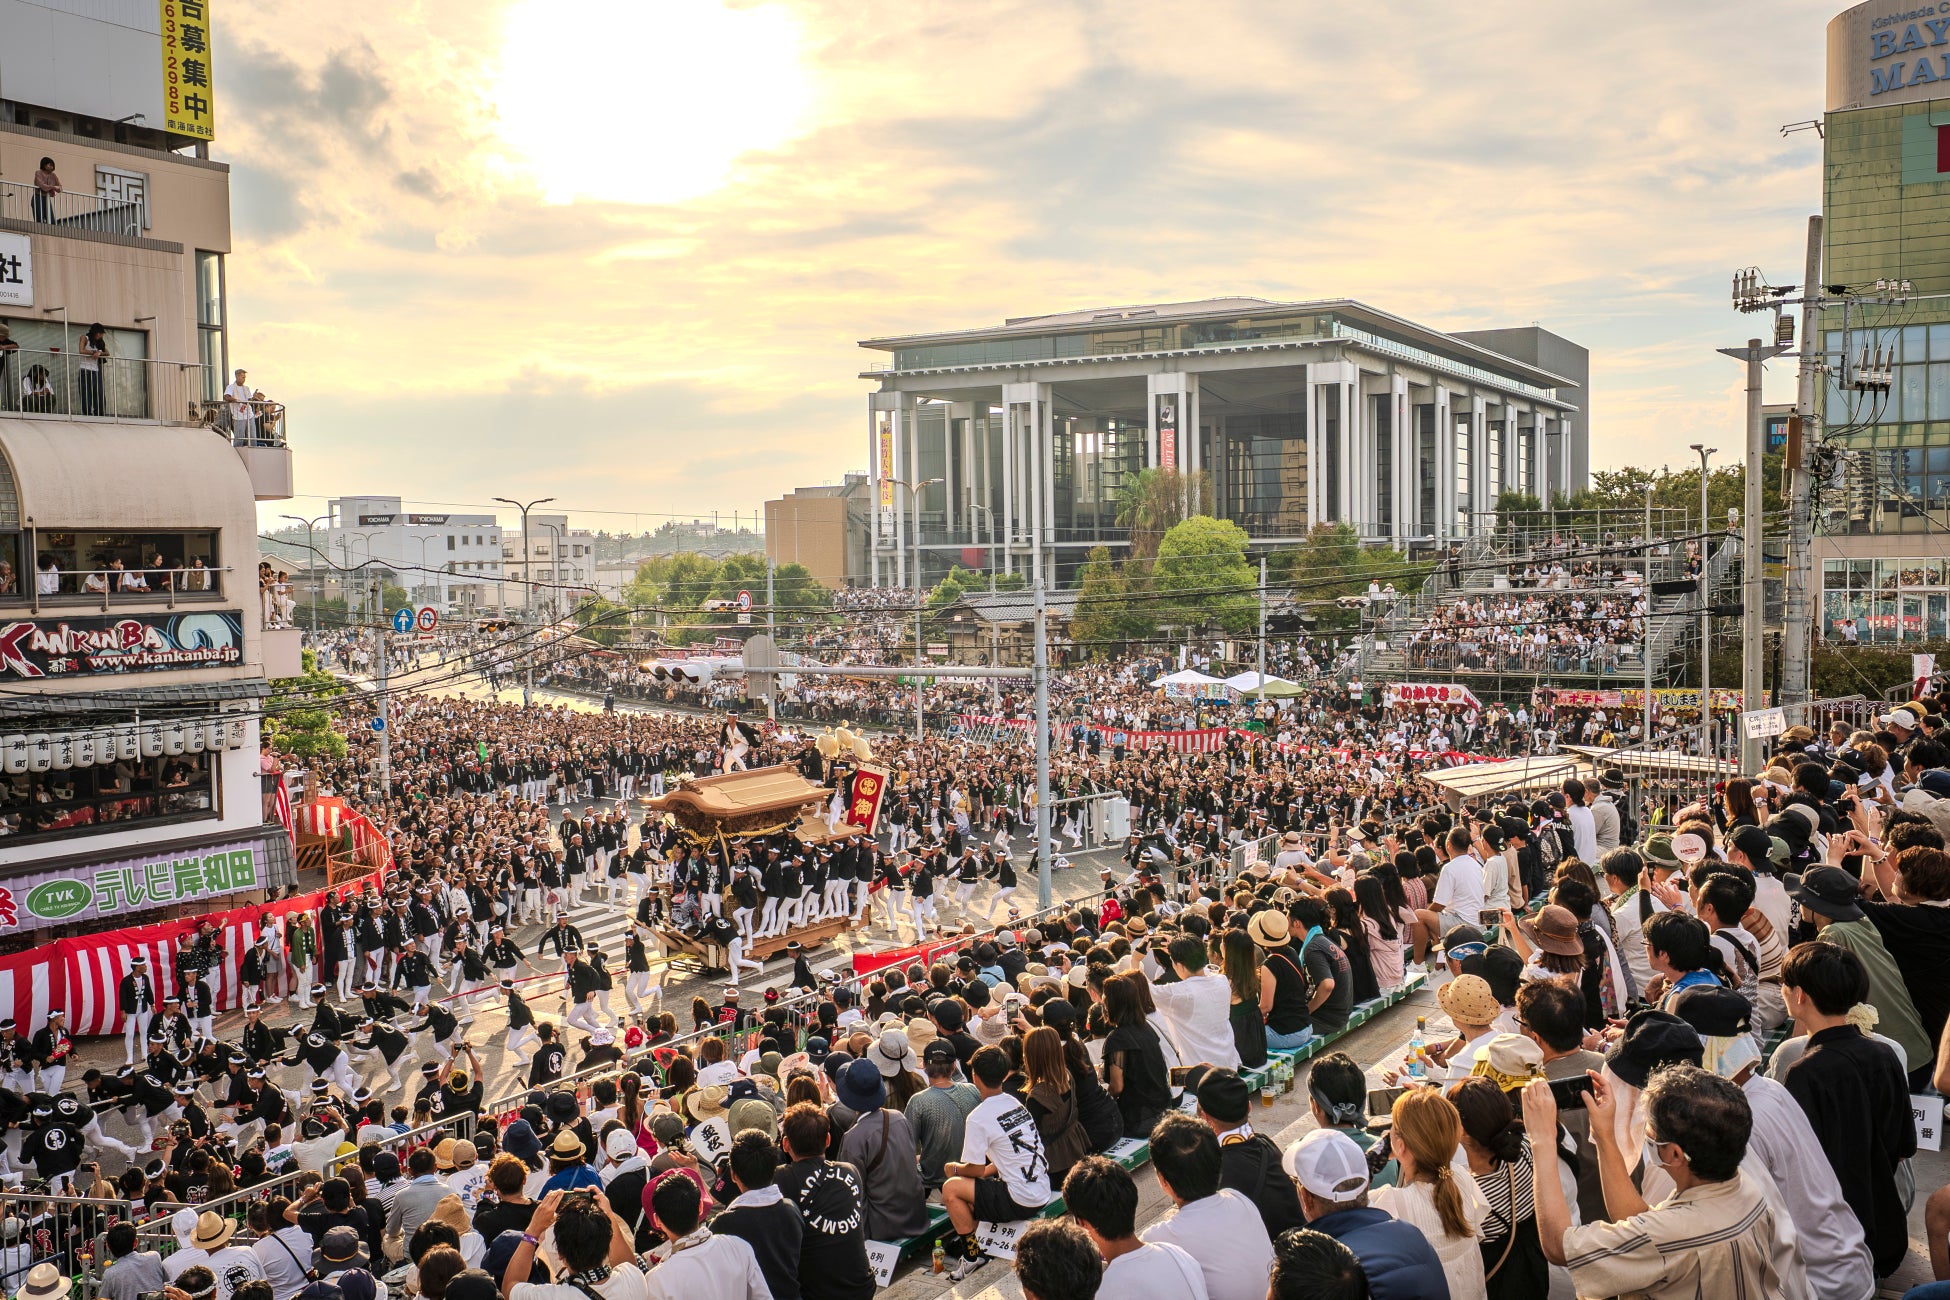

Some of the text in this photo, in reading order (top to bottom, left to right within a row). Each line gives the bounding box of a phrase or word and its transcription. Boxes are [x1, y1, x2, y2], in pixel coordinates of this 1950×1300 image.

[1871, 6, 1935, 30] Kishiwada
[164, 0, 180, 115] 632-2985
[740, 596, 749, 607] 50
[88, 648, 240, 668] www.kankanba.jp
[1400, 685, 1450, 702] いかやき
[1660, 693, 1699, 706] はしまき
[854, 798, 874, 819] 御
[94, 848, 257, 912] テレビ岸和田
[45, 888, 76, 904] TVK
[462, 1175, 487, 1201] BRUI
[809, 1208, 861, 1235] FRGMT
[989, 1222, 1017, 1238] B 9列
[870, 1252, 885, 1263] 8列
